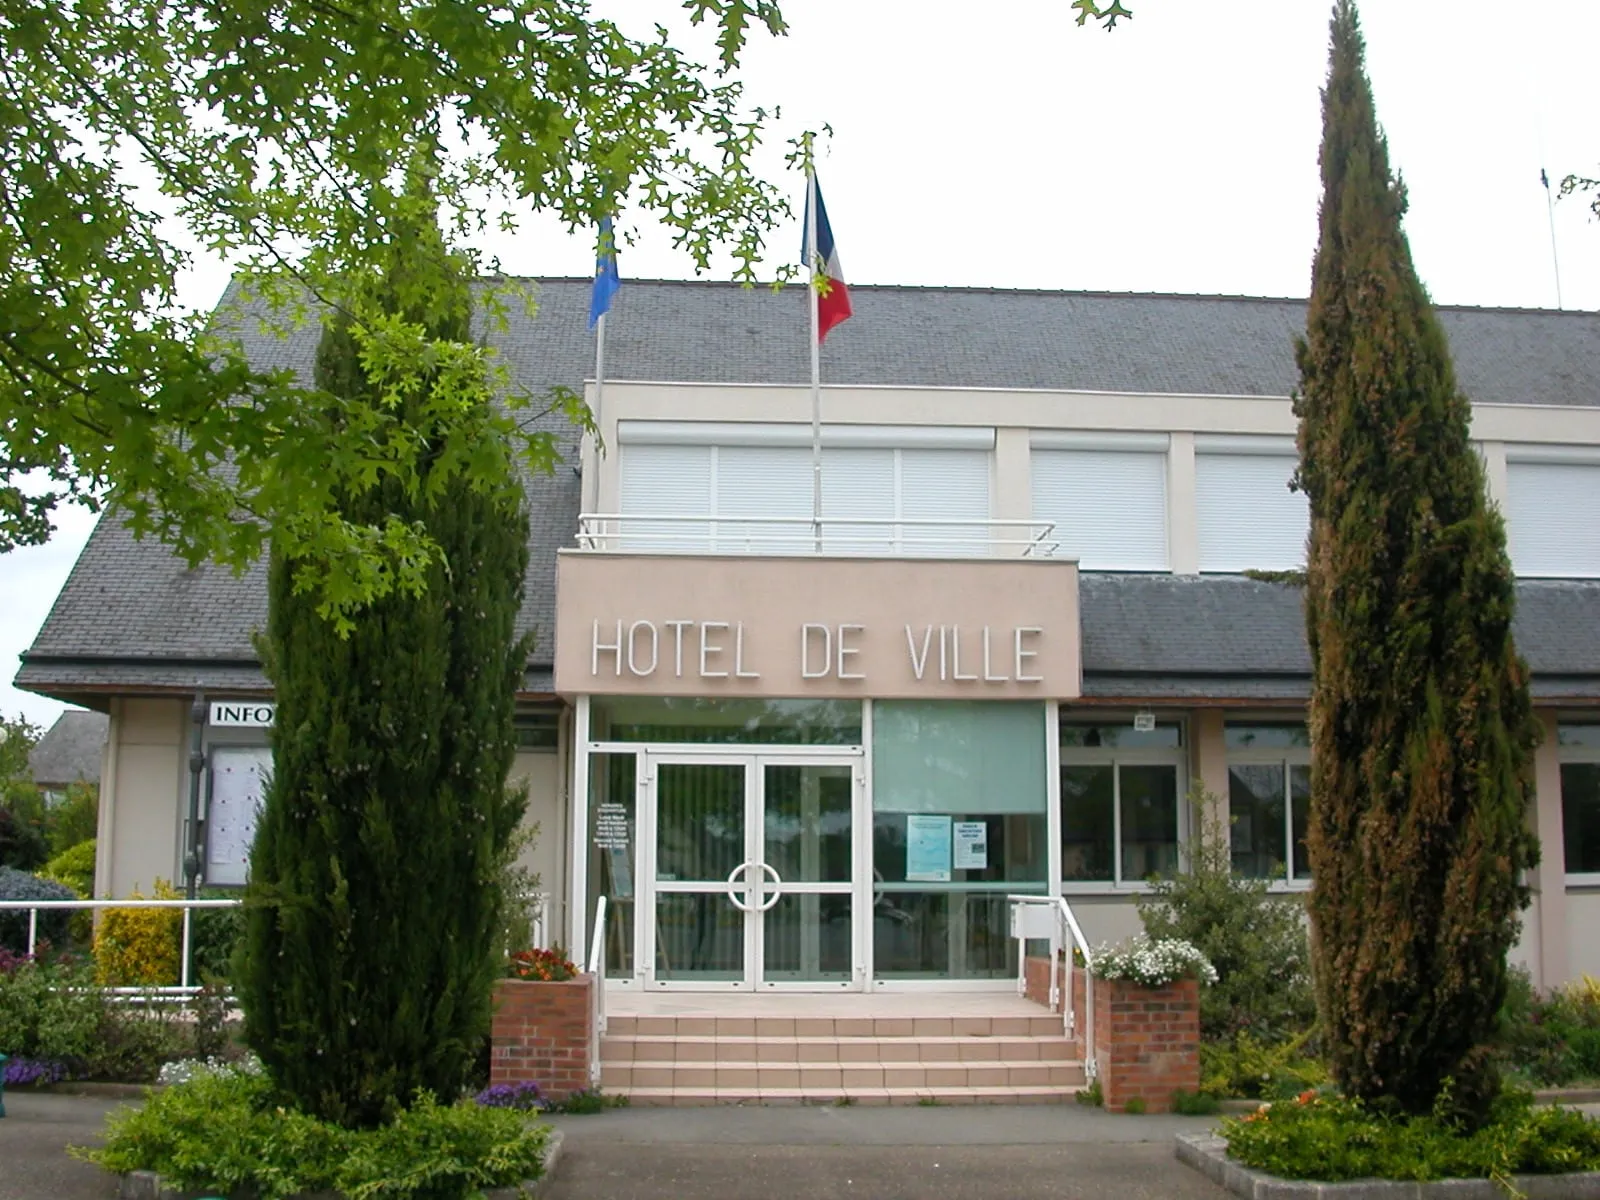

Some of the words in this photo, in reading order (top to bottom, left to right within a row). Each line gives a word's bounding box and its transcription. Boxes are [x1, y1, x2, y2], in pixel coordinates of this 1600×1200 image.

[592, 618, 760, 679] HOTEL
[801, 624, 866, 680] DE
[905, 624, 1044, 682] VILLE
[216, 706, 273, 723] INFO
